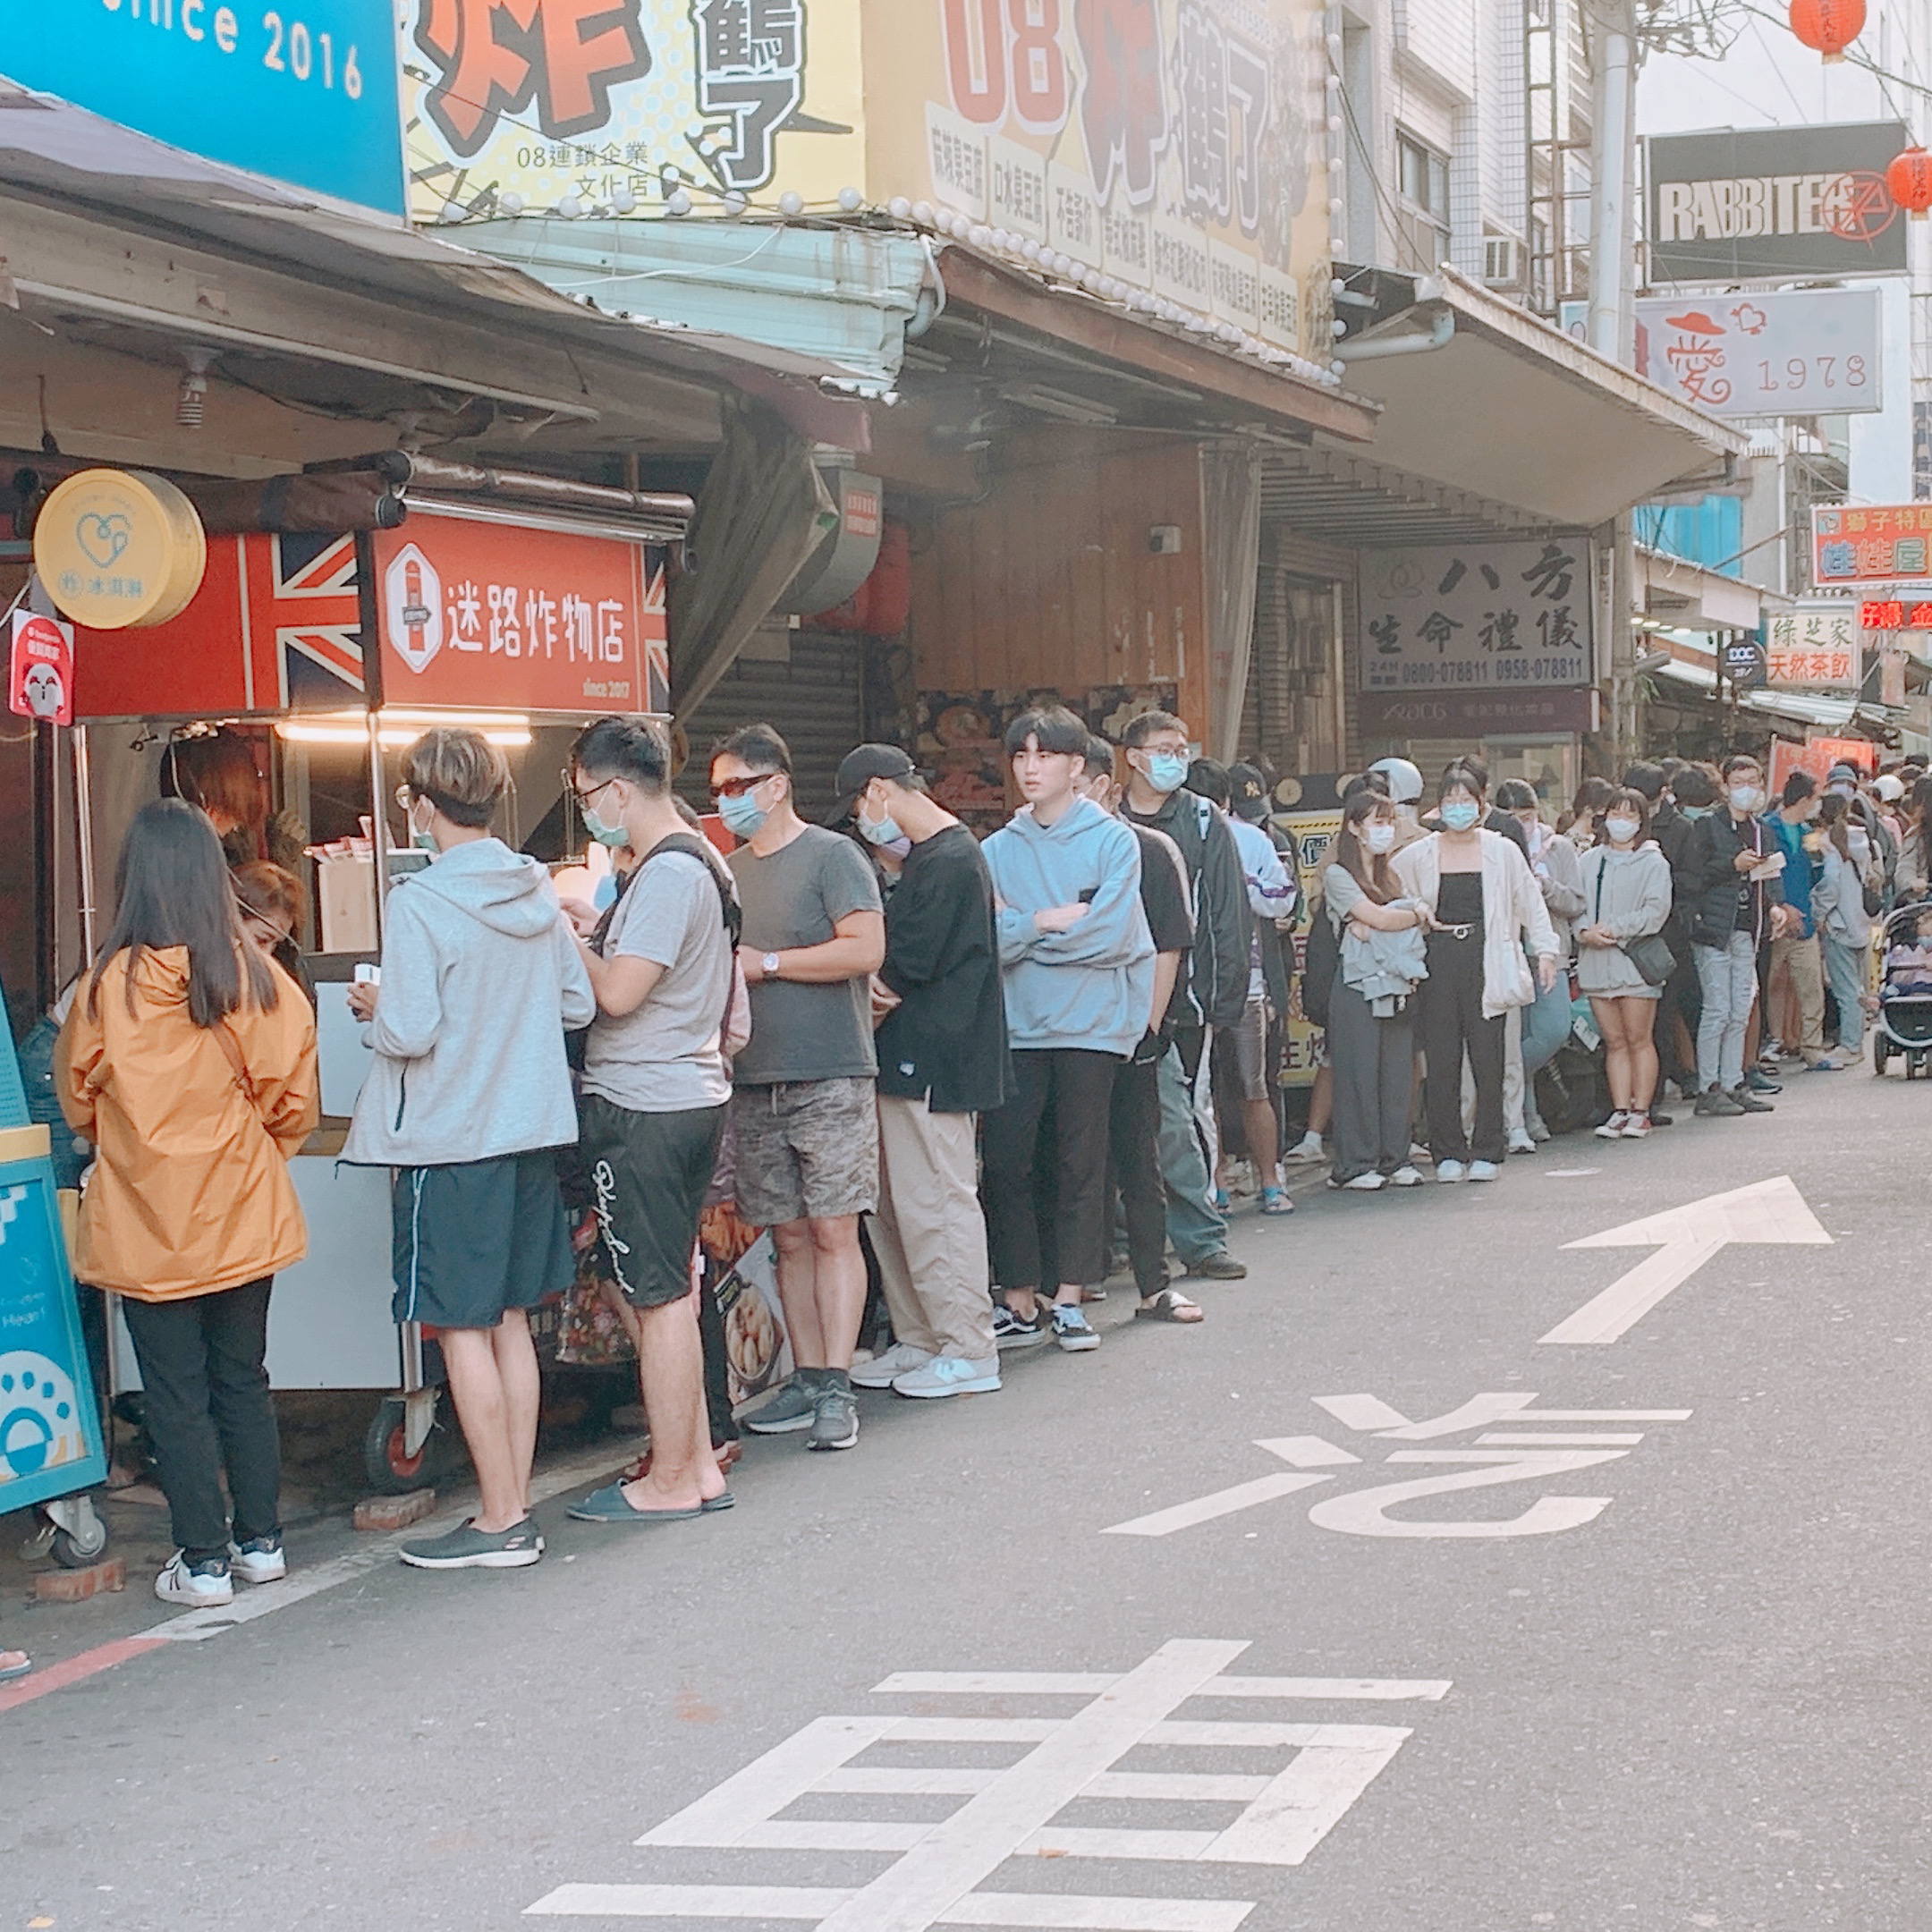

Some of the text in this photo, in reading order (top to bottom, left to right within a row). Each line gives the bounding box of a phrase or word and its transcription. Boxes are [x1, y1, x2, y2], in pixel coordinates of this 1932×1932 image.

[101, 0, 362, 100] nce 2016
[516, 140, 648, 168] 08連鎖企業
[574, 174, 648, 199] 文化店
[1757, 355, 1867, 392] 1978
[1436, 544, 1576, 601] 八方
[448, 580, 624, 663] 迷路炸物店
[1368, 606, 1583, 655] 生命禮儀
[1768, 652, 1851, 681] 天然茶飲
